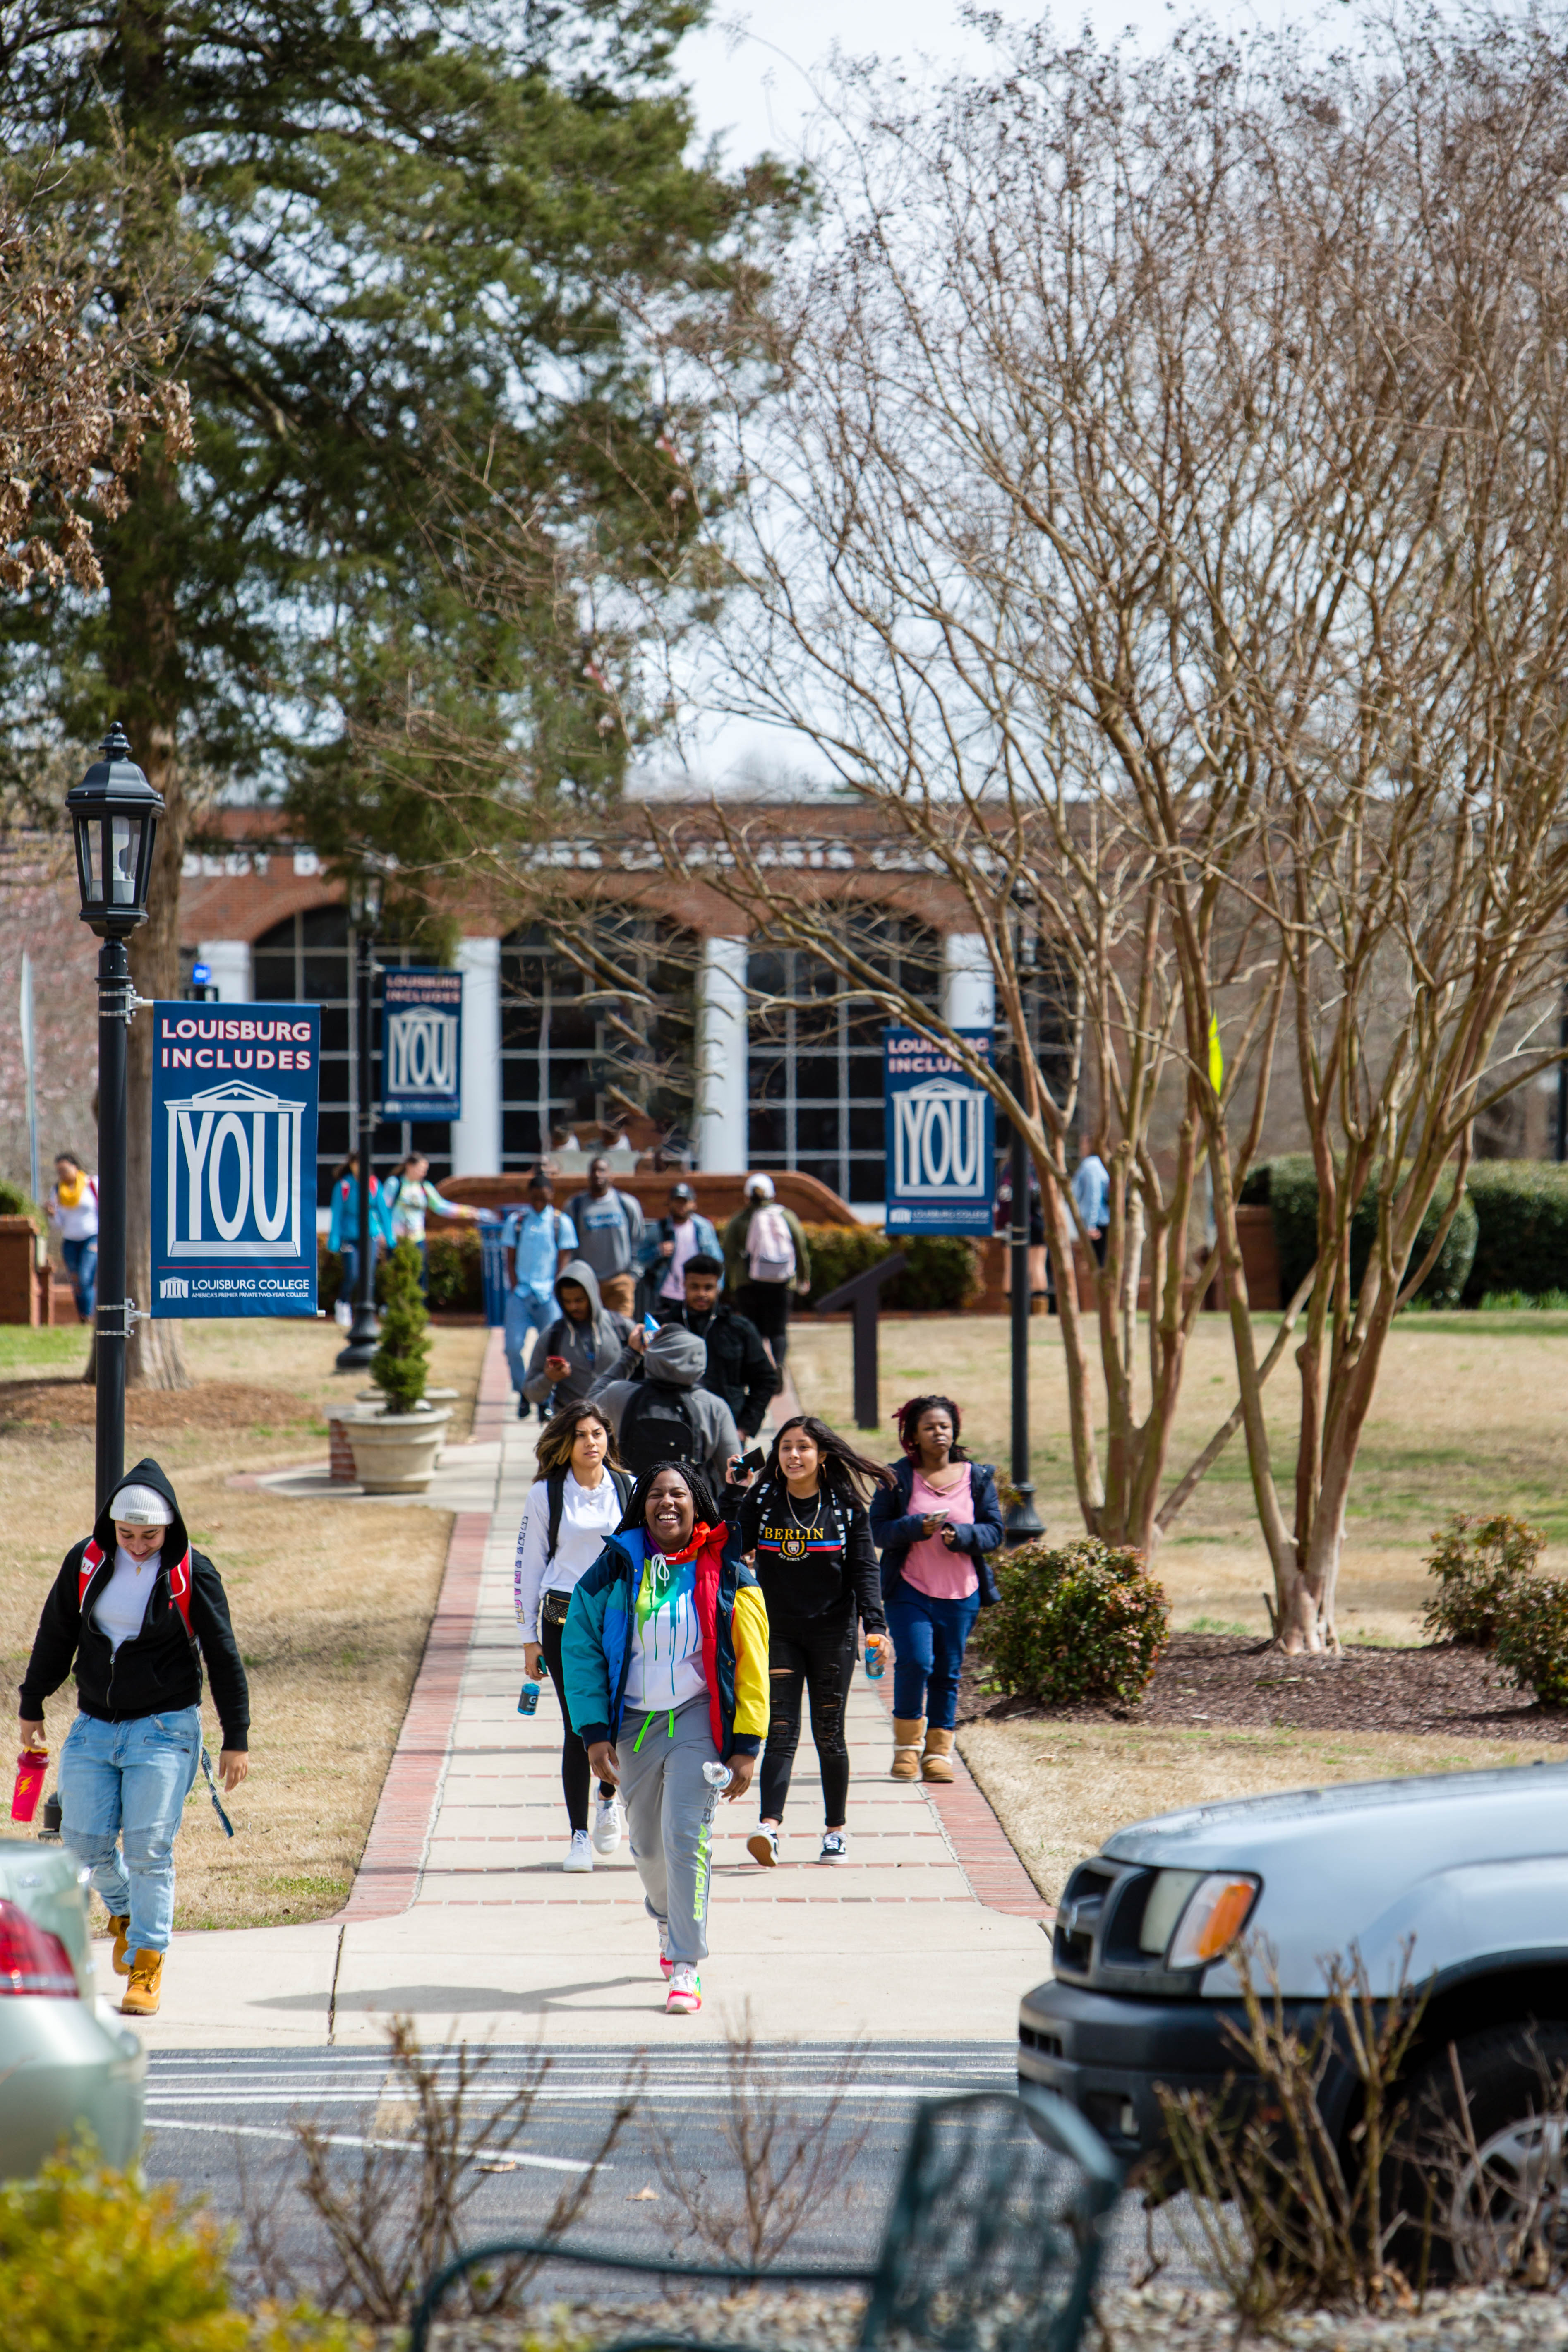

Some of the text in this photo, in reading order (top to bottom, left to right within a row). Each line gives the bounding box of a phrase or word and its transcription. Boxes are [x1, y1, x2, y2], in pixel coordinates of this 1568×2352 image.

[162, 1019, 311, 1041] LOUISBURG
[162, 1048, 311, 1070] INCLUDES
[395, 1023, 449, 1086] YOU
[904, 1100, 976, 1186] YOU
[177, 1112, 289, 1241] YOU
[192, 1279, 309, 1290] LOUISBURG COLLEGE
[765, 1527, 824, 1540] BERLIN
[693, 1823, 708, 1921] ARMOUR
